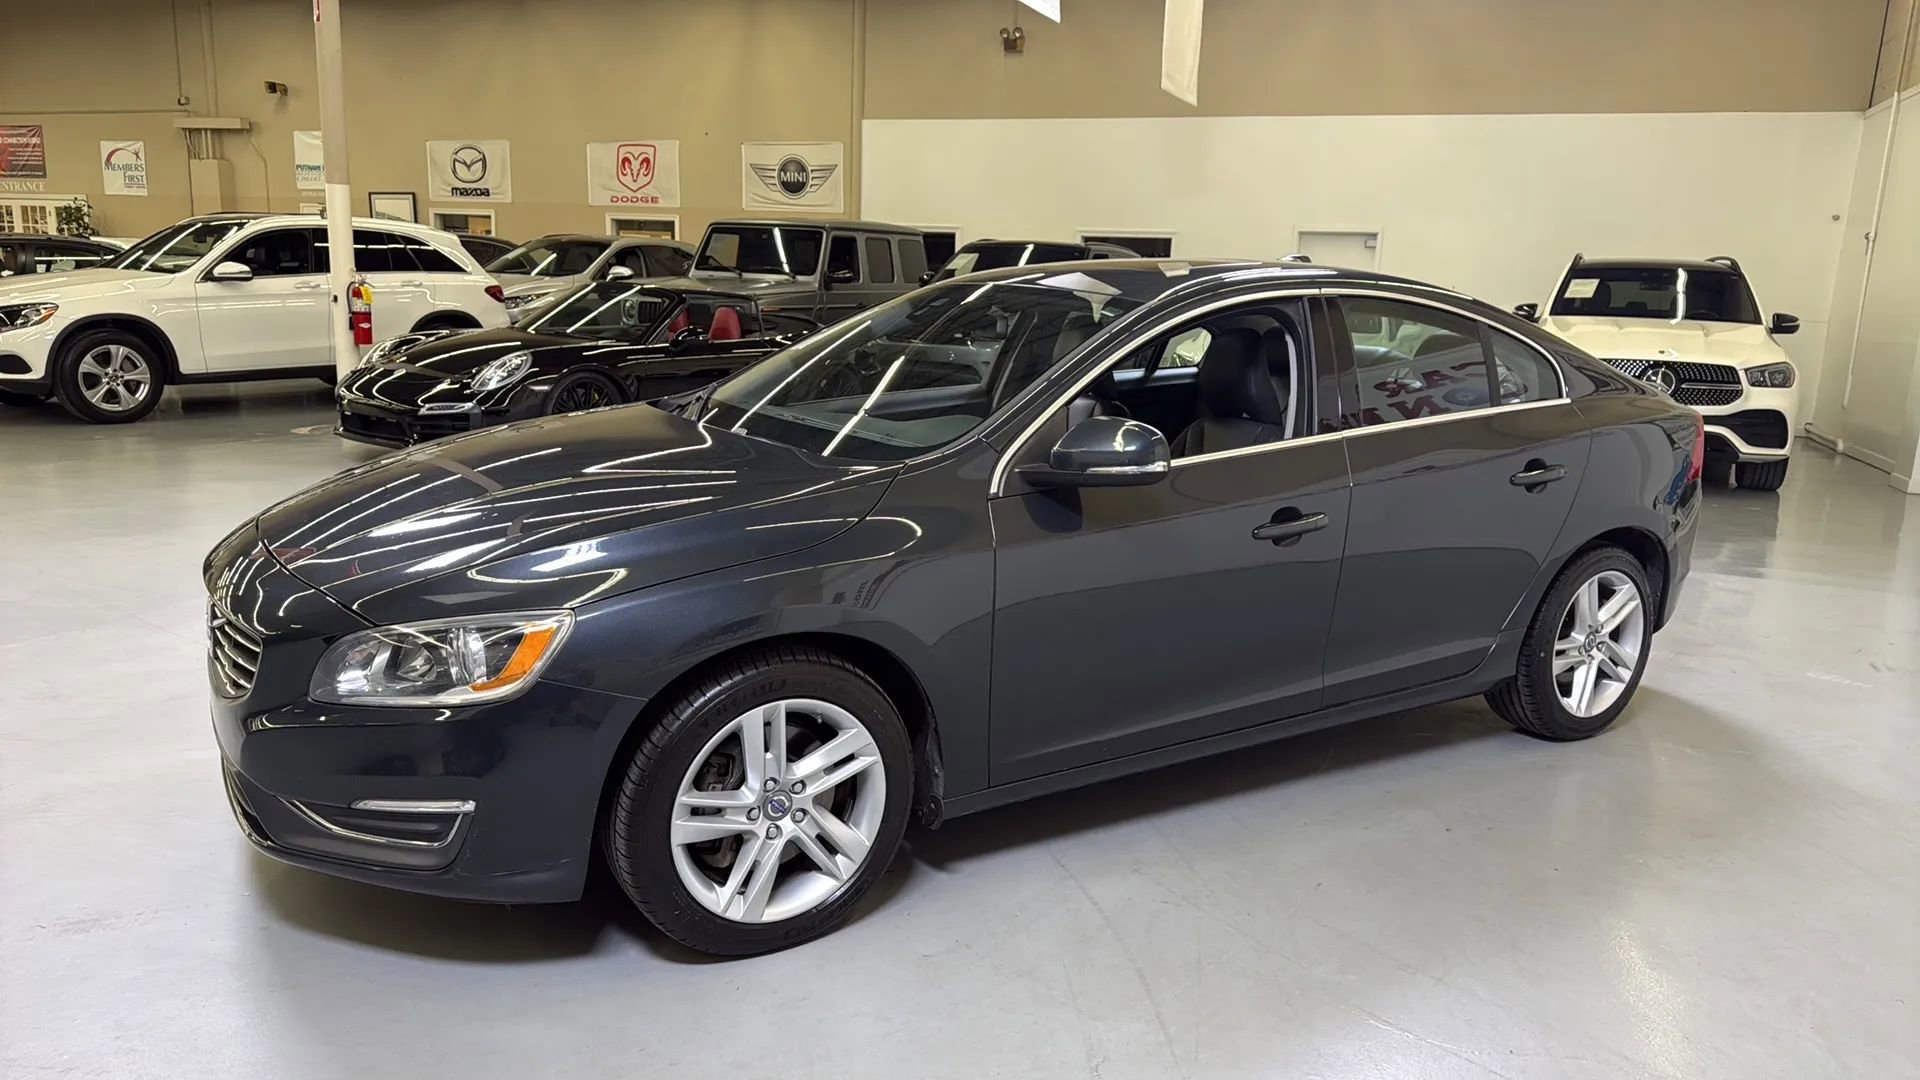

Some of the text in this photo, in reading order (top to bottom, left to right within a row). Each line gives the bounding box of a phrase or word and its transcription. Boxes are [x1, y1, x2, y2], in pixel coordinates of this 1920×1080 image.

[104, 162, 144, 172] MEMBERS
[123, 172, 144, 183] FIRST
[780, 171, 807, 182] MINI
[451, 187, 490, 197] mazda
[610, 195, 660, 204] DODGE
